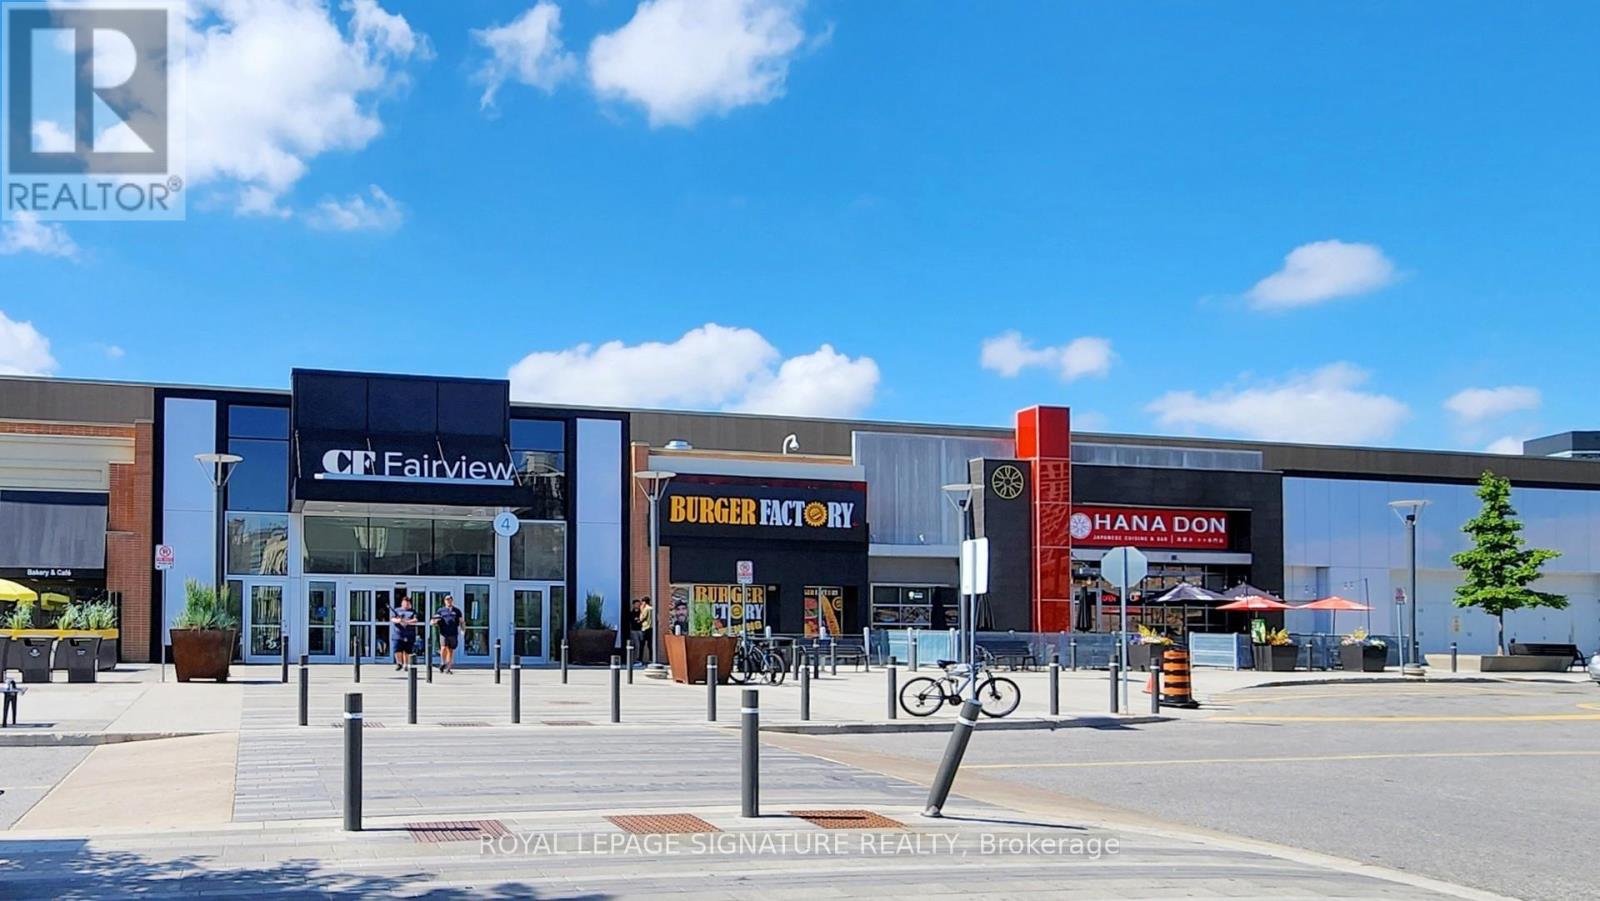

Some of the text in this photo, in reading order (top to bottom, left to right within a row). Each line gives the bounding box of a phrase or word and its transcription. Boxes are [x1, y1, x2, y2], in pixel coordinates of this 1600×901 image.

[322, 449, 514, 480] CF Fairview
[670, 495, 855, 529] BURGER FACTORY
[500, 517, 511, 531] 4
[1094, 513, 1227, 534] HANA DON
[27, 569, 71, 578] Bakery & Café
[695, 585, 764, 603] BURGER
